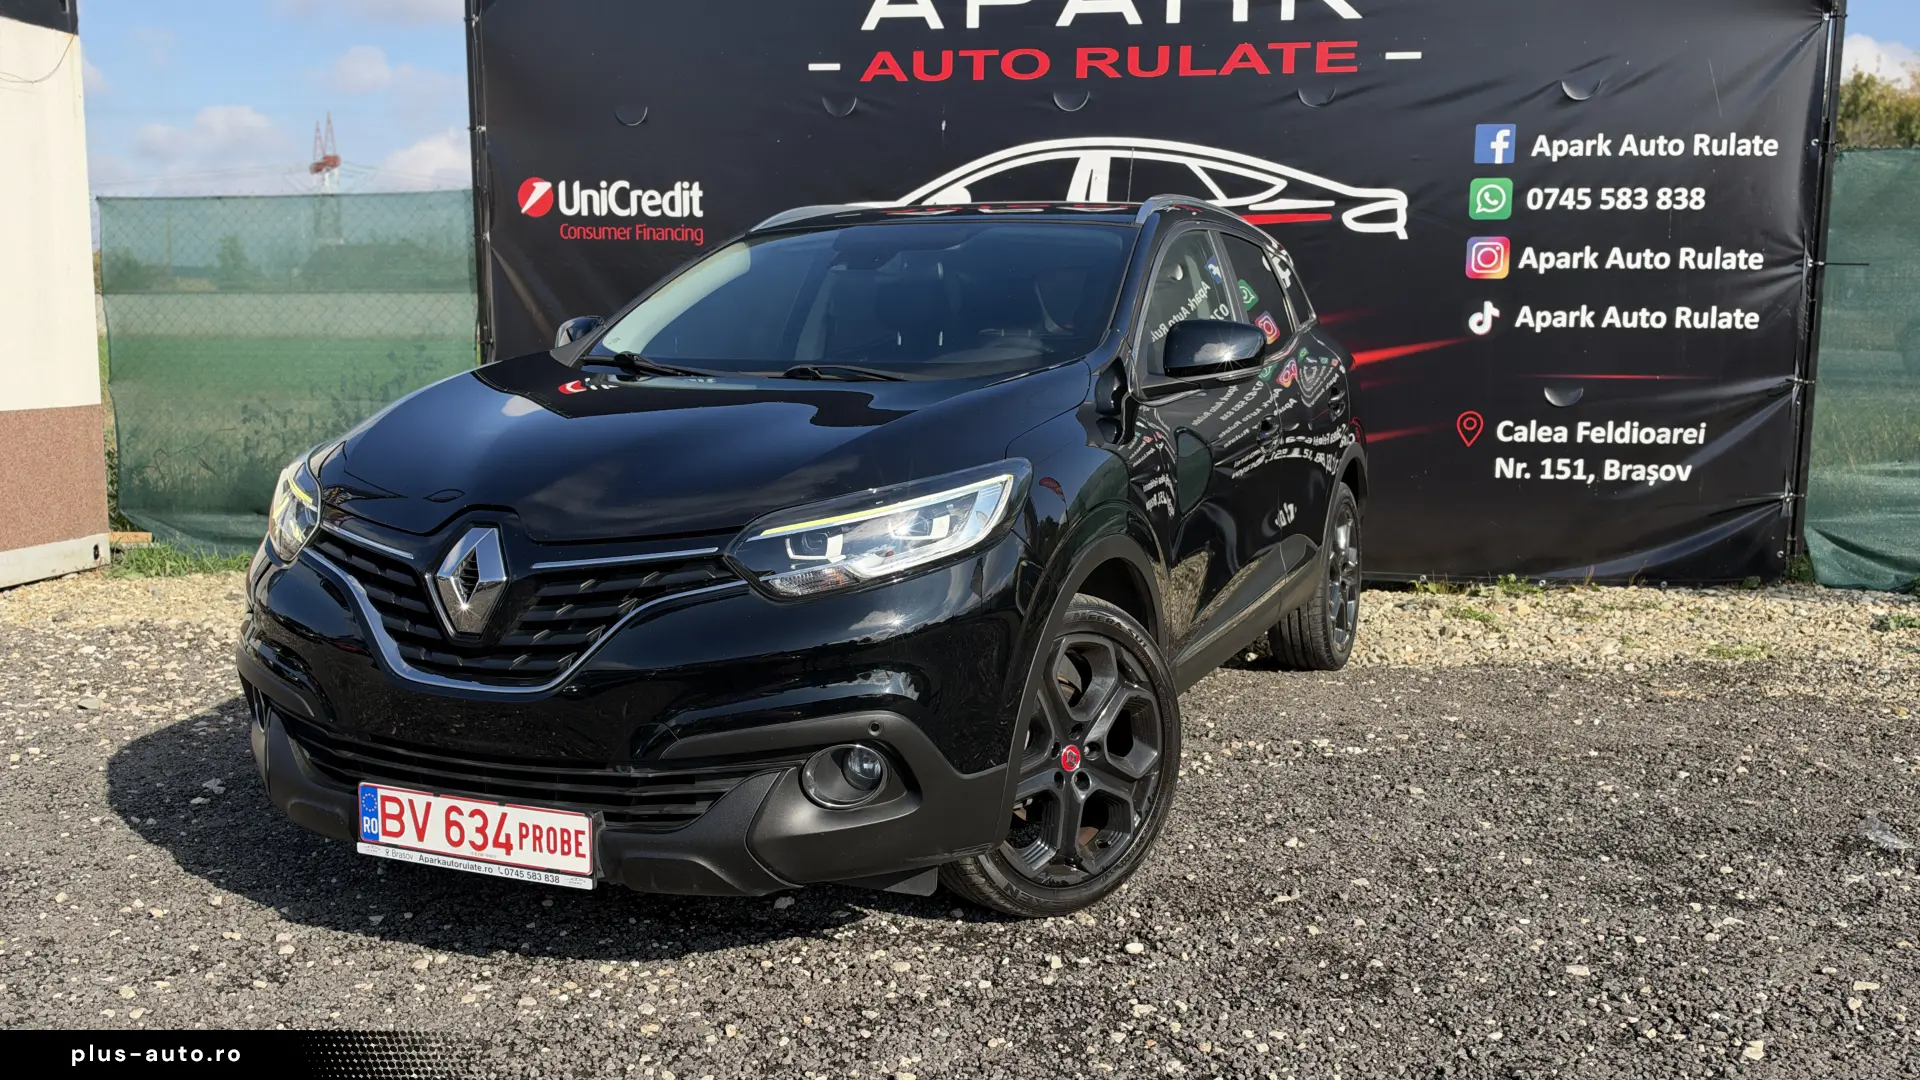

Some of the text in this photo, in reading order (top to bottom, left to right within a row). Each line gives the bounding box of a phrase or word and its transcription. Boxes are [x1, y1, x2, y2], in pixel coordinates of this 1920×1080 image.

[859, 40, 1359, 82] AUTO RULATE
[1531, 132, 1779, 162] Apark Auto Rulate
[557, 179, 704, 218] UniCredit
[1525, 187, 1706, 211] 0745 583 838
[559, 223, 705, 247] Consumer Financing
[1518, 245, 1764, 274] Apark Auto Rulate
[1515, 304, 1760, 333] Apark Auto Rulate
[1496, 419, 1707, 445] Calea Feldioarei
[1494, 457, 1693, 487] Nr. 151, Brașov
[362, 794, 587, 859] RO BV 634 PROBE
[418, 853, 494, 874] Aparkautorulate.ro
[504, 868, 525, 879] 0745
[526, 871, 542, 881] 583
